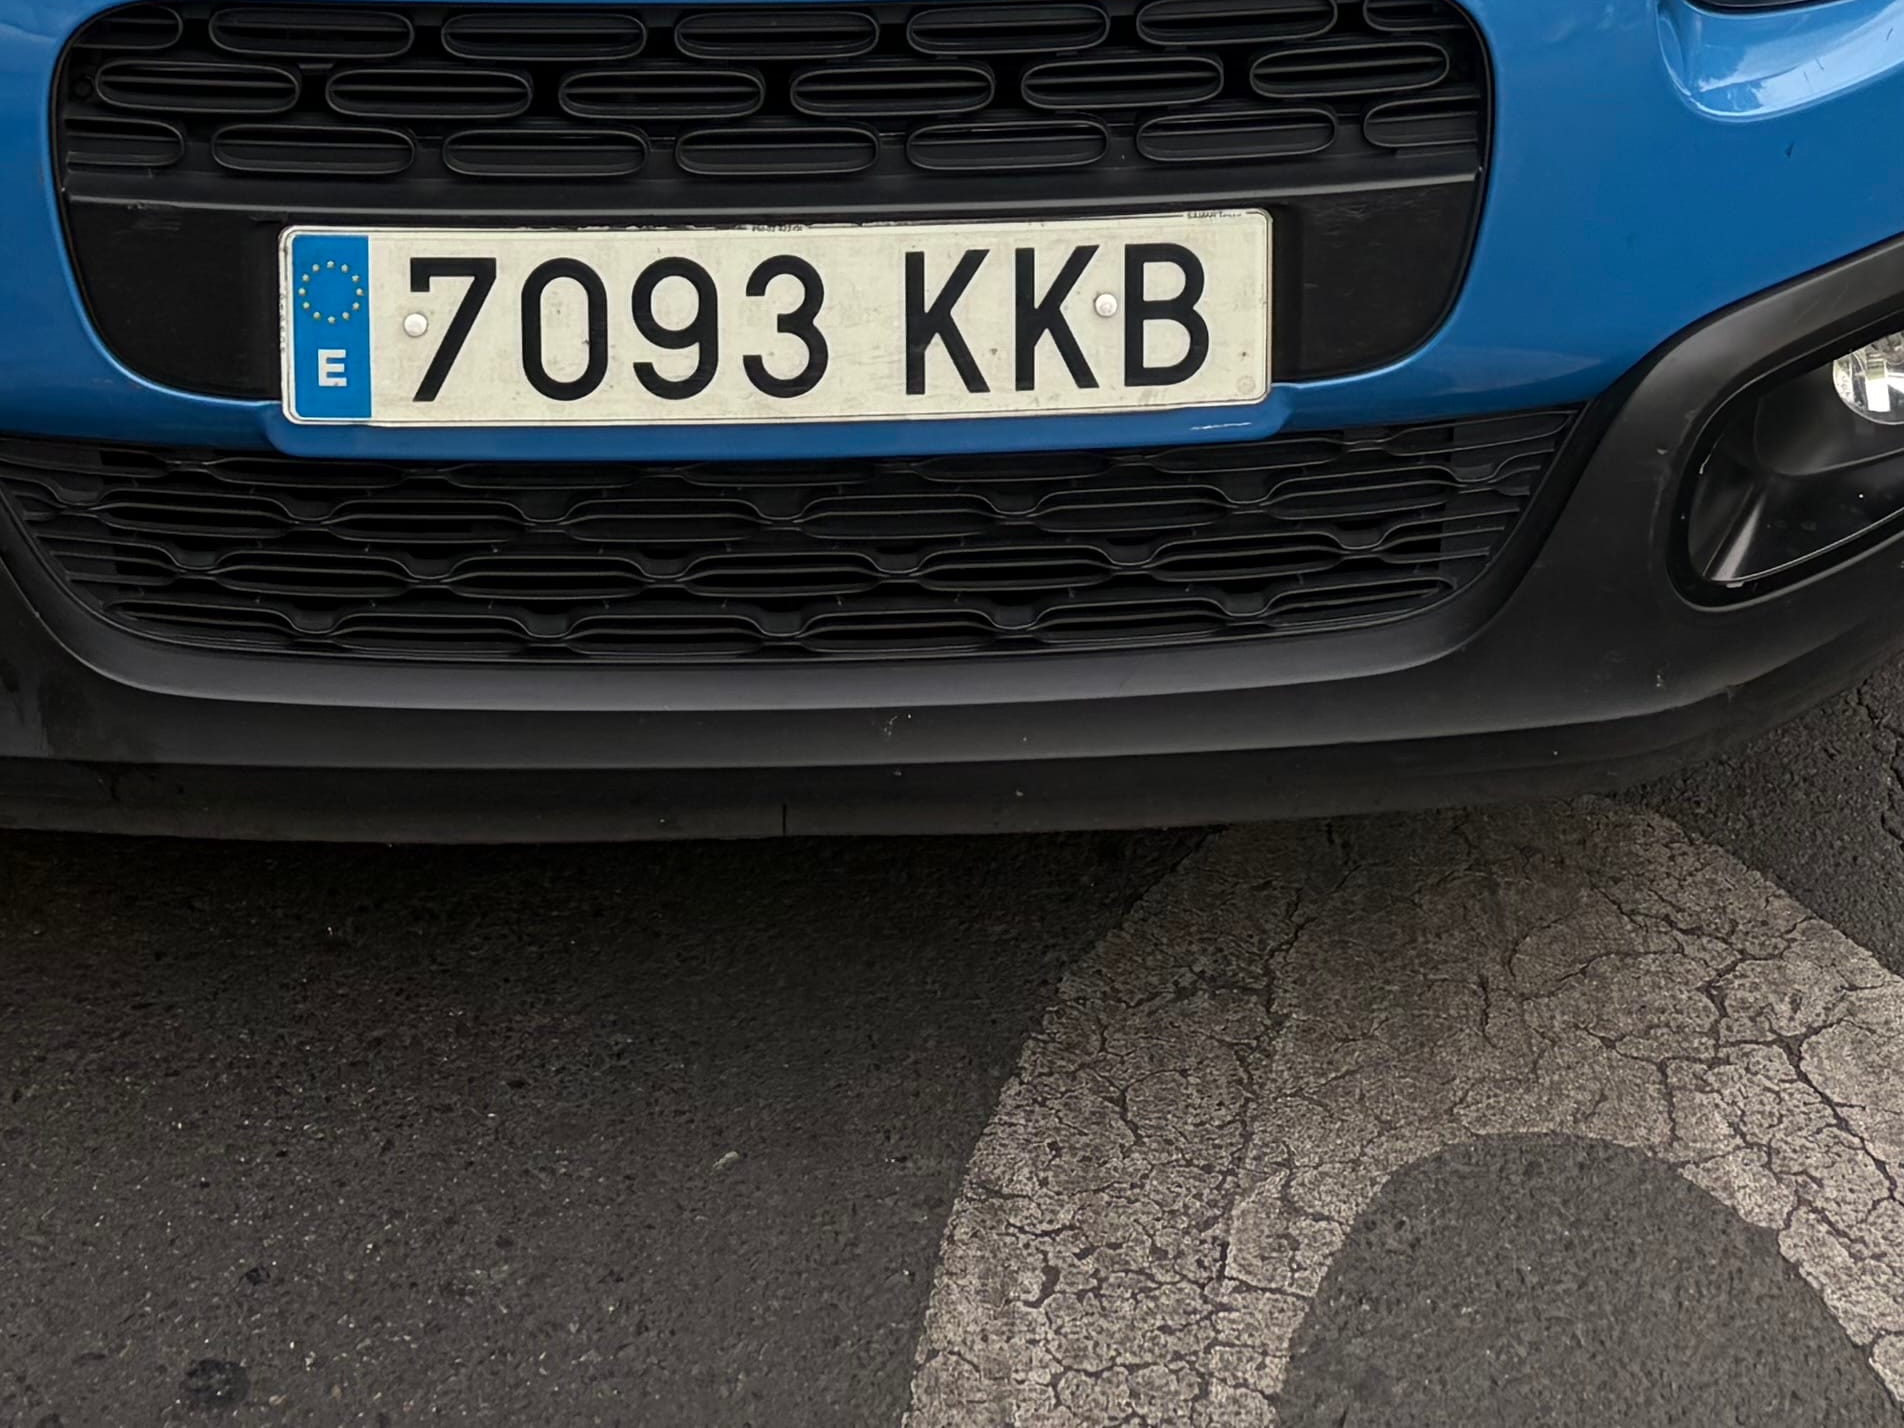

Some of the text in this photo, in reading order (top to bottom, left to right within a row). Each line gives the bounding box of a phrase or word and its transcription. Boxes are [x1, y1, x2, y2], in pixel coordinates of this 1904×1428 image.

[317, 349, 347, 388] E
[409, 241, 1210, 402] 7093 KKB
